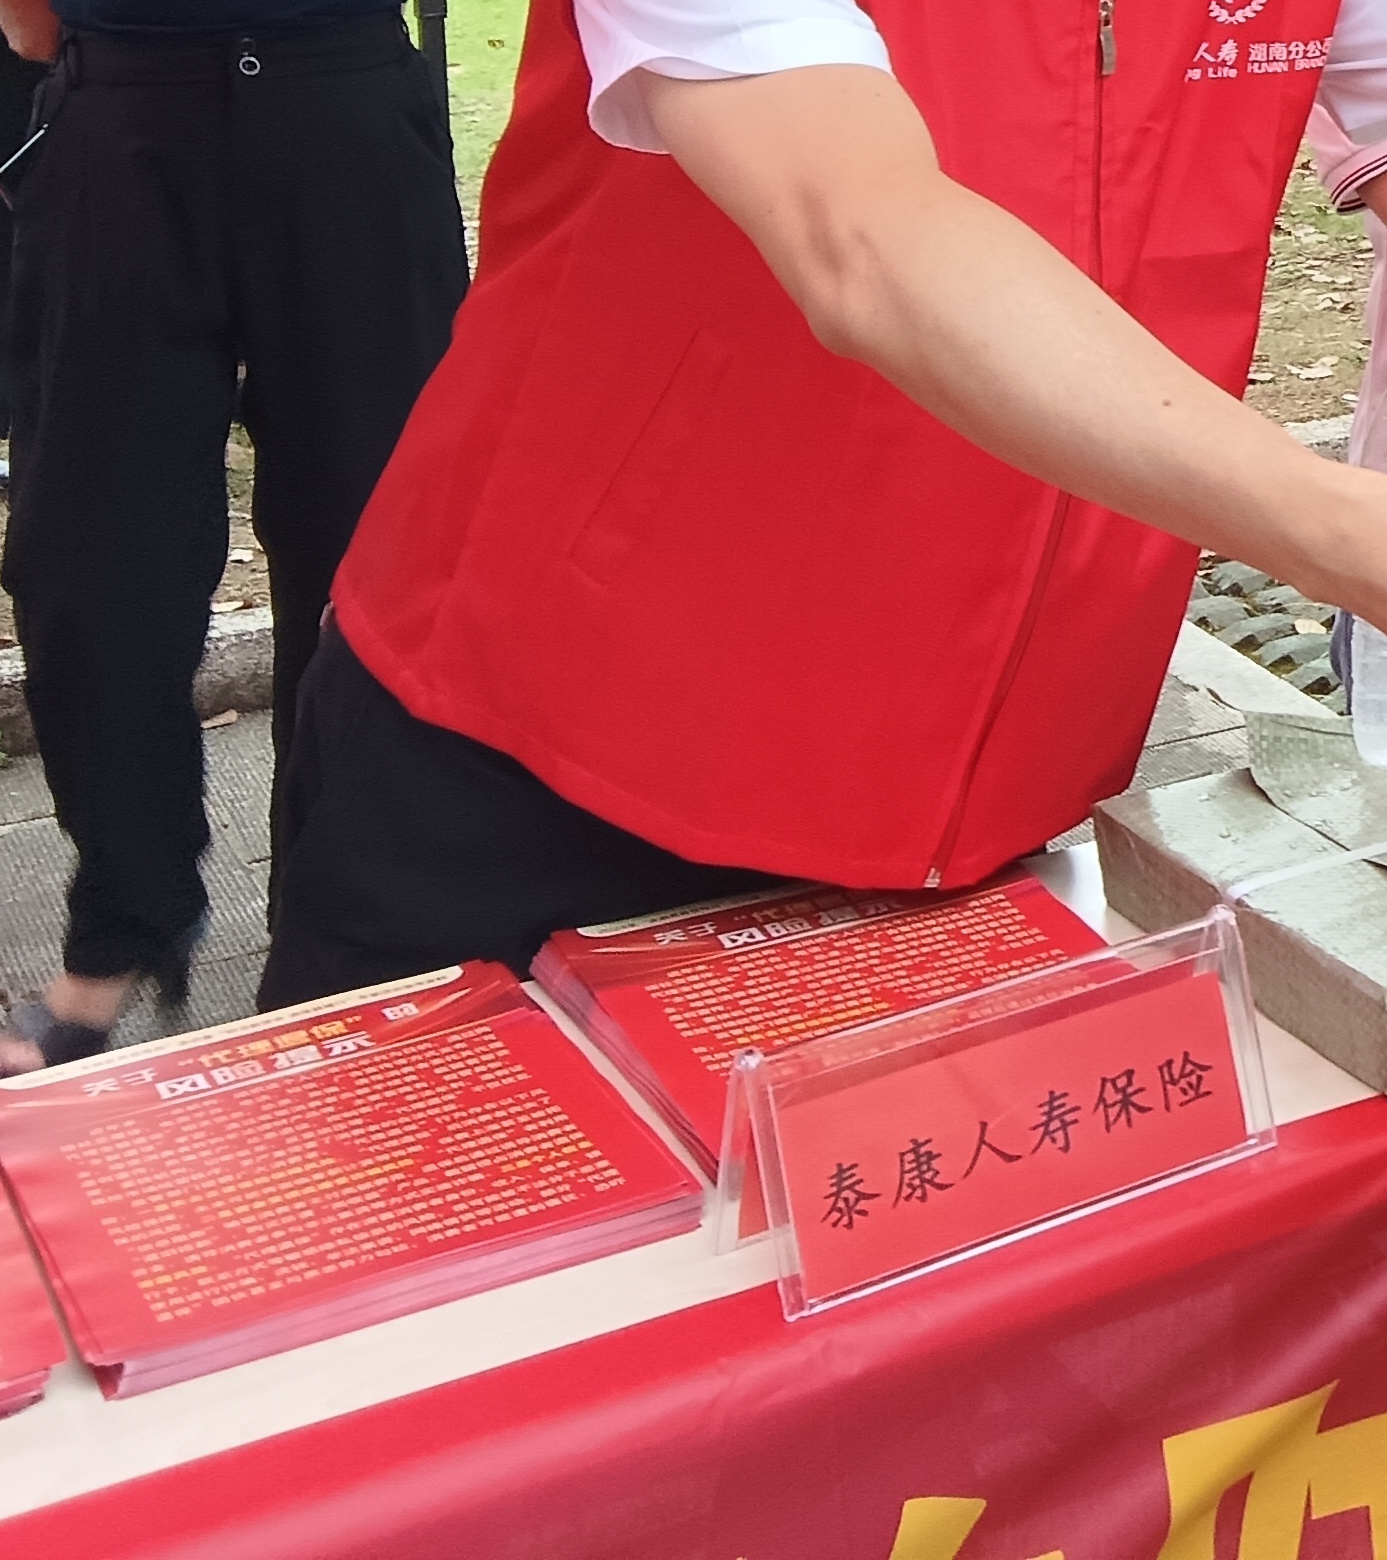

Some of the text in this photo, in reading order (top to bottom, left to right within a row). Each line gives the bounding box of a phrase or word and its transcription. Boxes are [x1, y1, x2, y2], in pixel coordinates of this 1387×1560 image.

[1207, 66, 1239, 80] Life
[154, 1031, 376, 1101] 风险提示
[820, 1049, 1213, 1230] 泰康人寿保险
